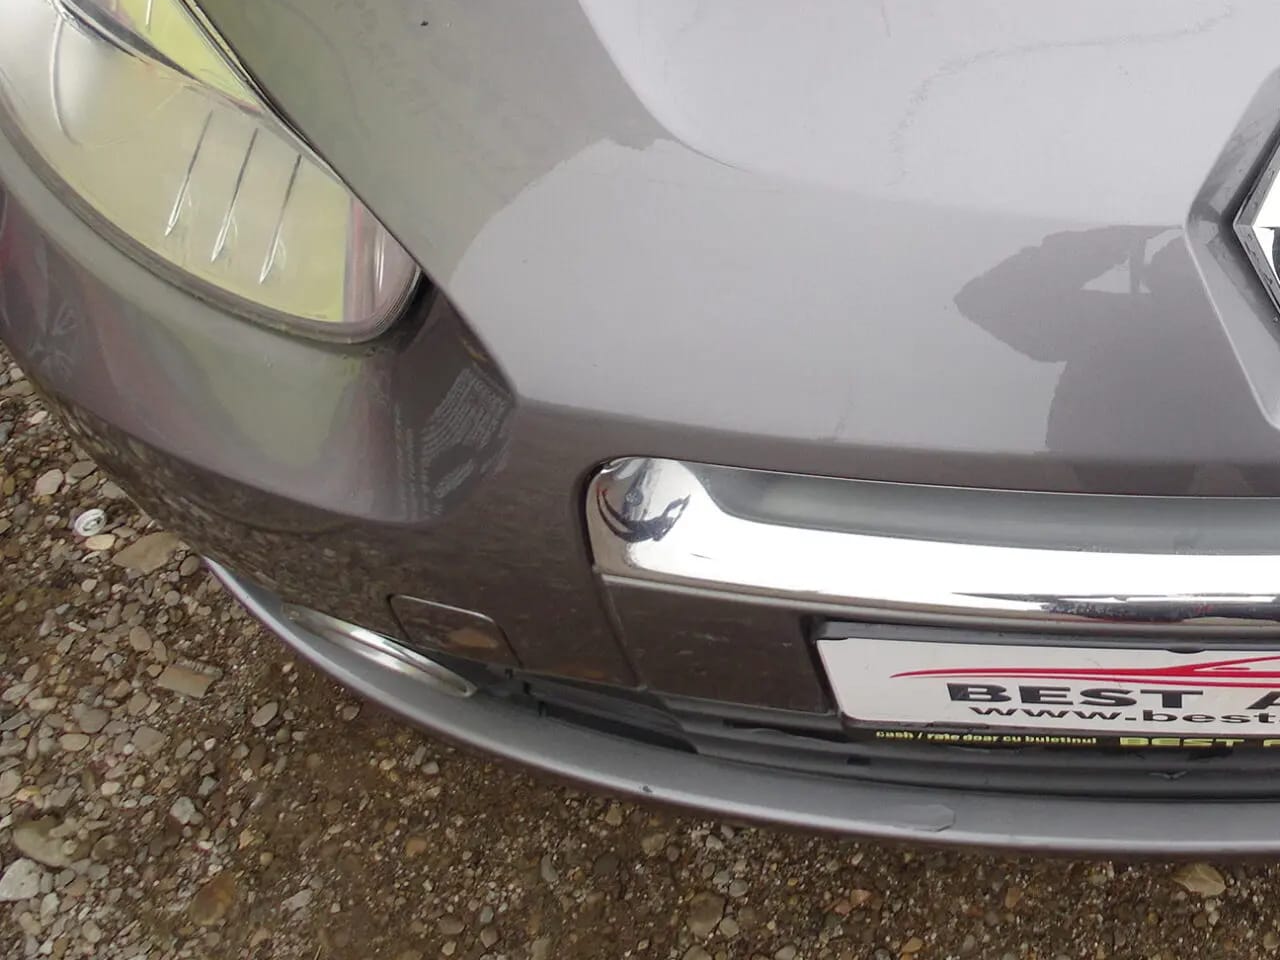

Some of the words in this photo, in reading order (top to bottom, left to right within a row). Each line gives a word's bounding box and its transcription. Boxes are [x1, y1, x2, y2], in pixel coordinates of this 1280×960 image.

[946, 683, 1204, 709] BEST
[927, 733, 961, 741] rate
[962, 733, 999, 743] doar
[1024, 735, 1097, 744] buletinul
